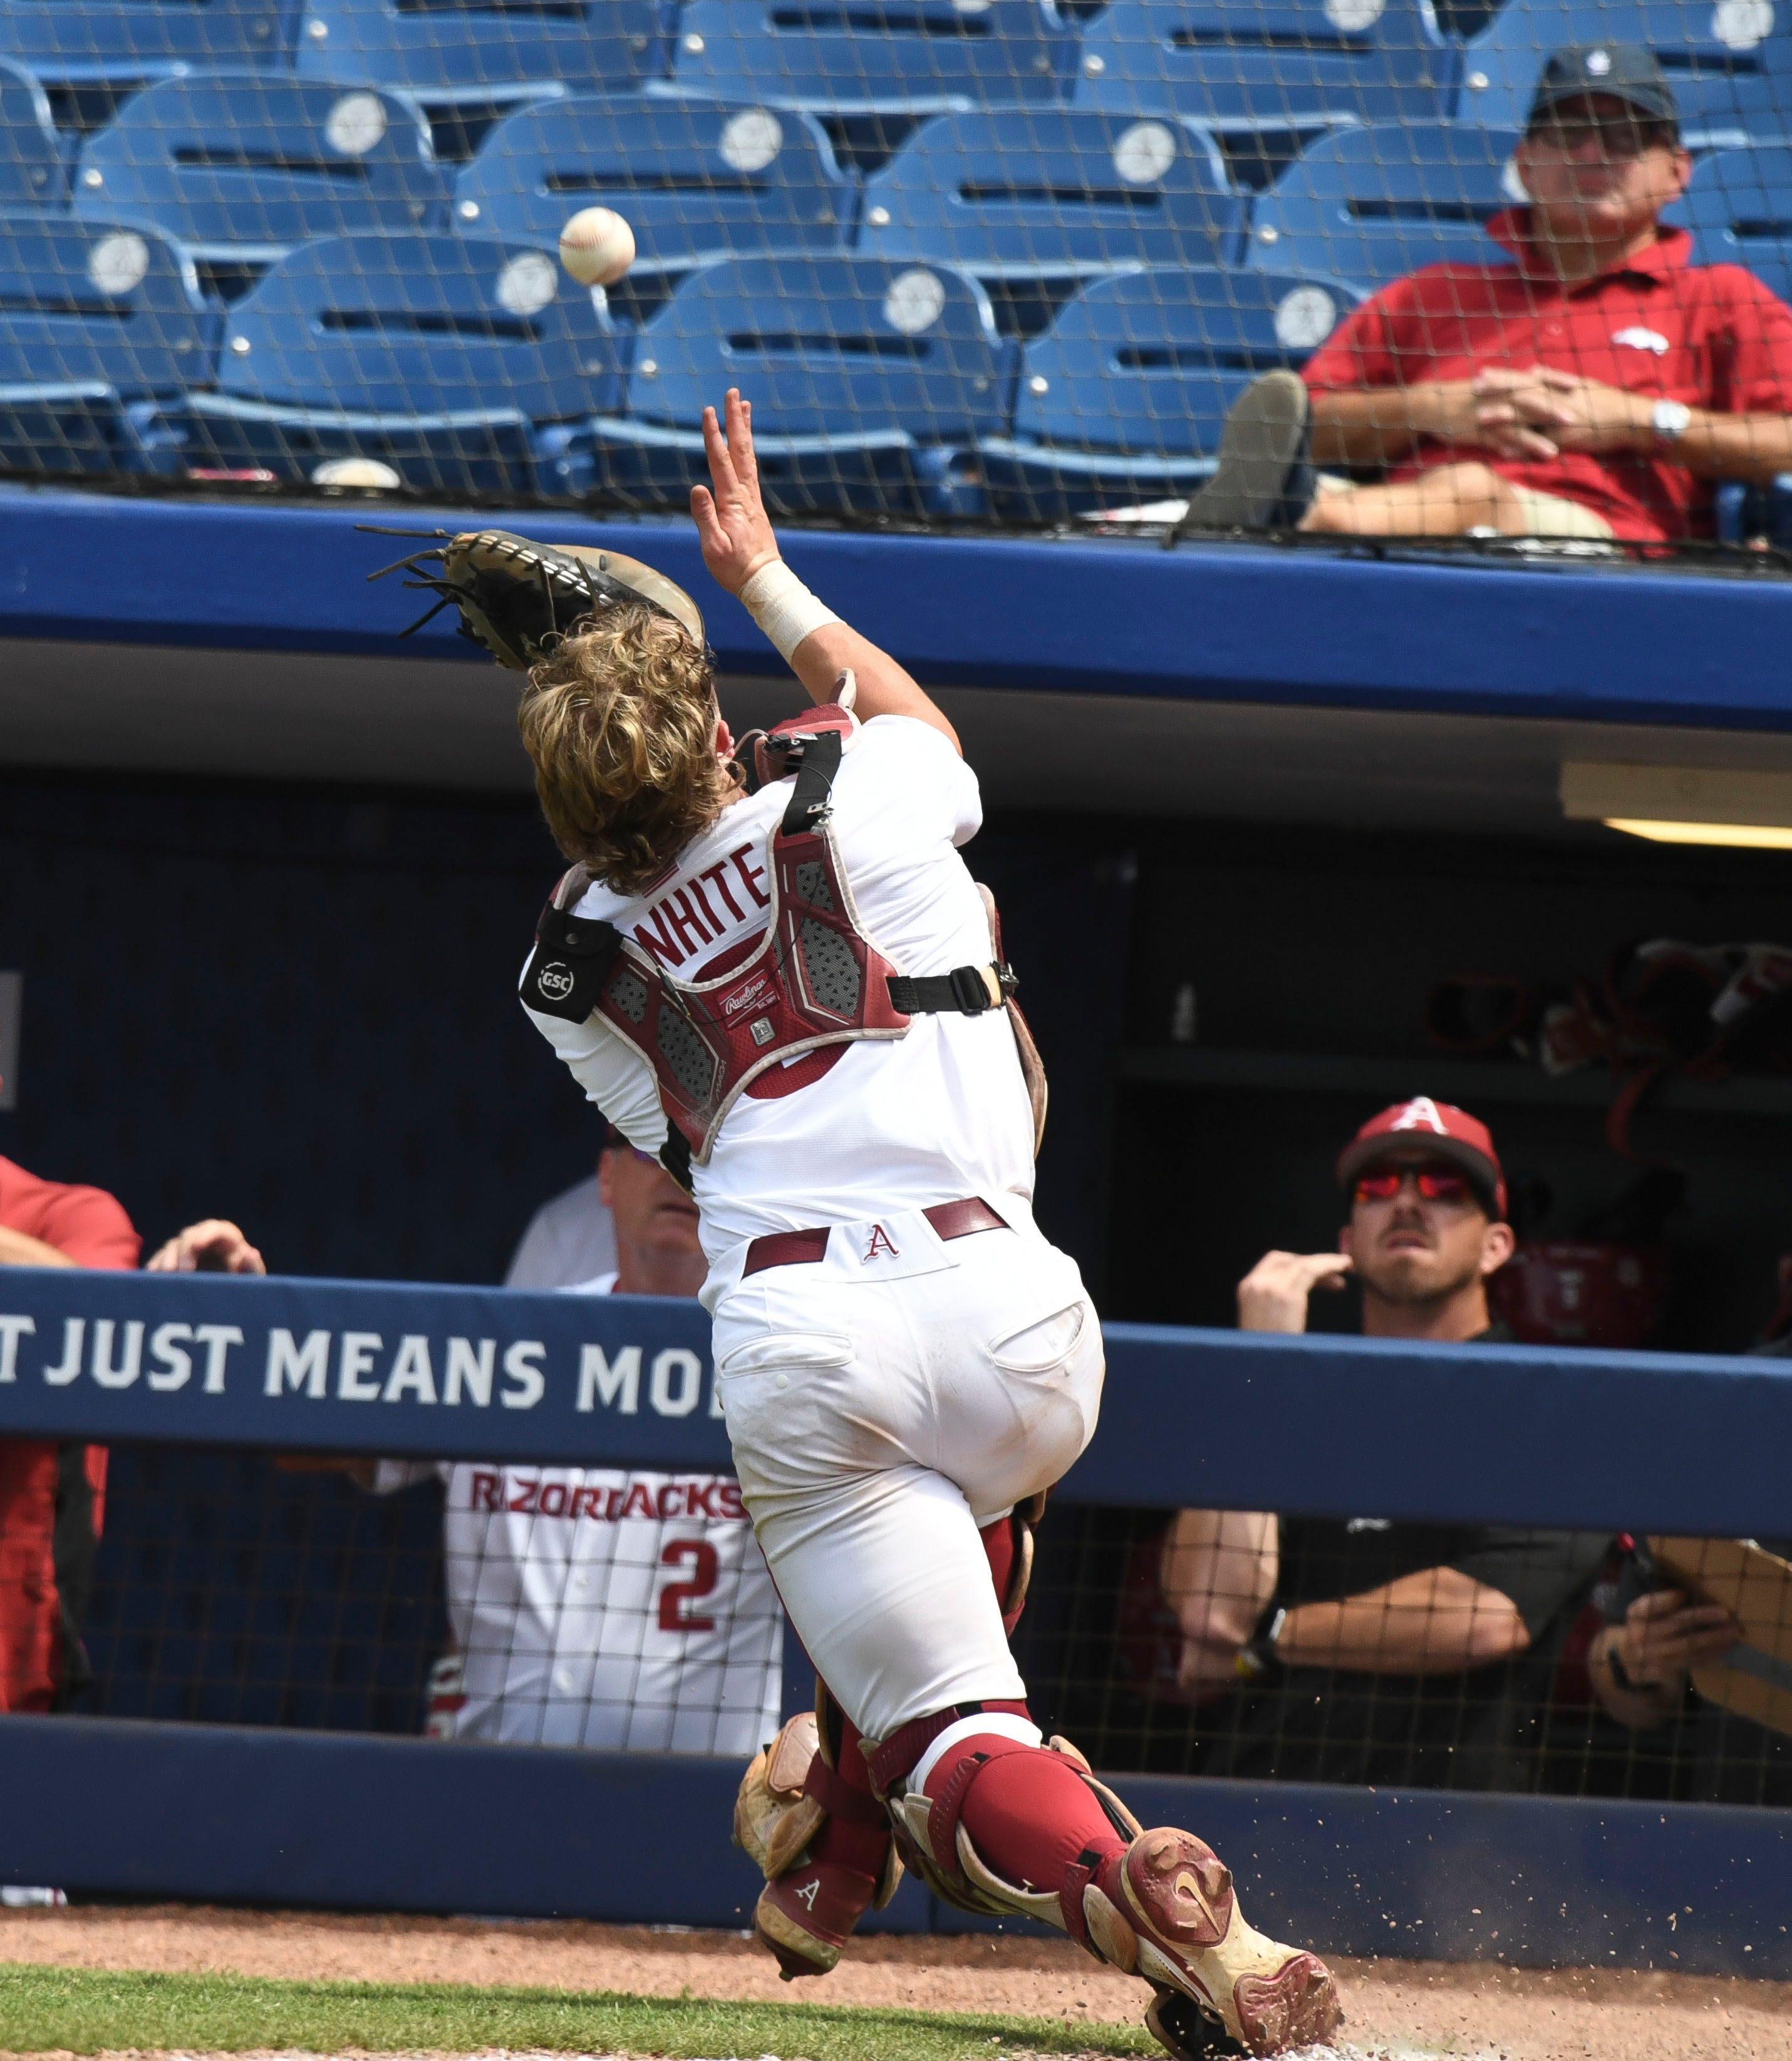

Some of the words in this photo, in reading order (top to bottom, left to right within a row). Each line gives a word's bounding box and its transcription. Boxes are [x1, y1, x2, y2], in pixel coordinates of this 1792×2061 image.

[542, 972, 569, 991] GSC
[1390, 1096, 1449, 1135] A
[862, 1222, 901, 1264] A
[42, 1316, 245, 1393] JUST
[262, 1327, 547, 1410] MEANS
[575, 1343, 725, 1419] MO
[659, 1539, 718, 1631] 2
[794, 1878, 820, 1911] A
